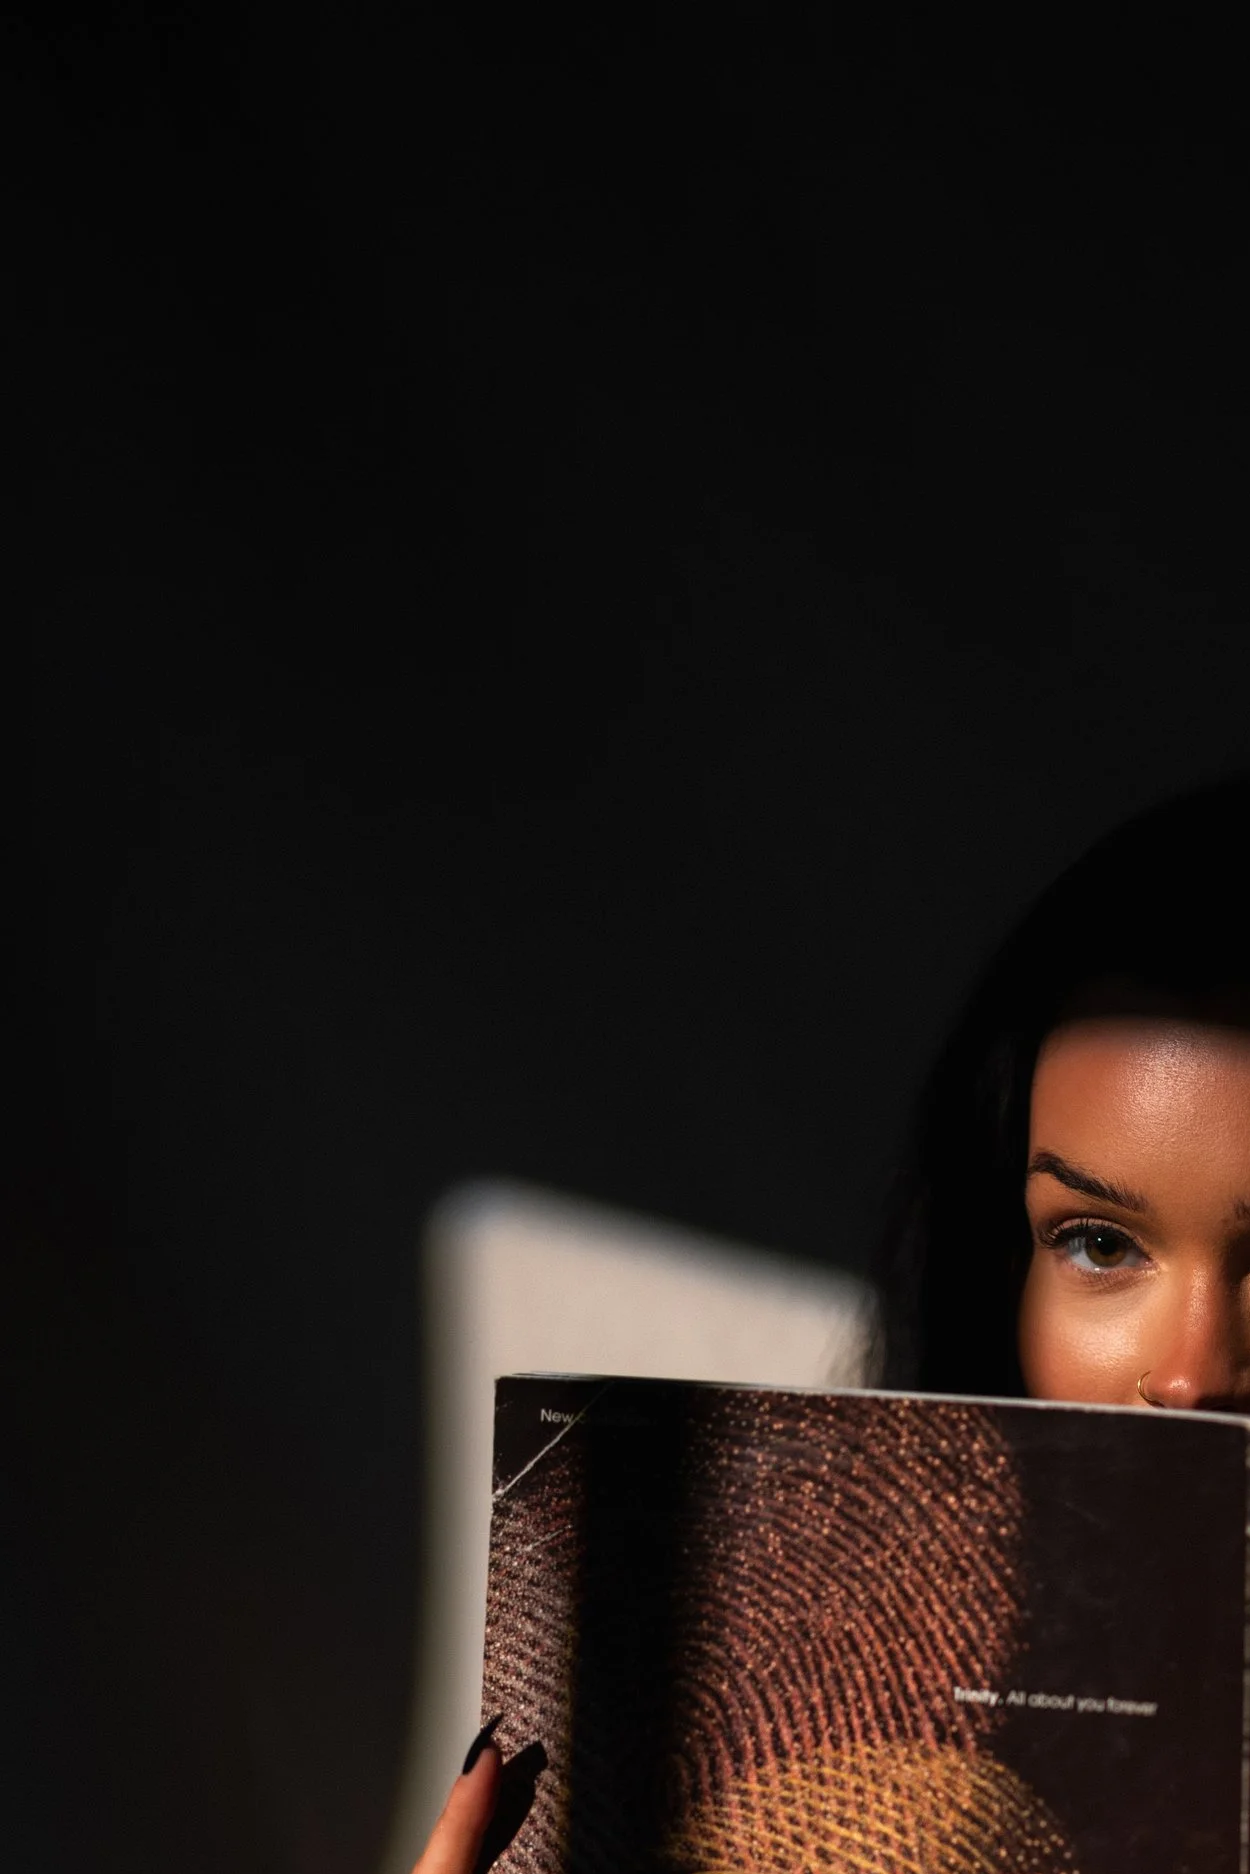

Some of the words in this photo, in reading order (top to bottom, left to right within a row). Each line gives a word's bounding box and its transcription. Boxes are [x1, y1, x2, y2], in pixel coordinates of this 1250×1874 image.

[540, 1407, 575, 1424] New
[1006, 1690, 1025, 1706] All
[1027, 1692, 1075, 1710] about
[1076, 1698, 1105, 1713] you
[1107, 1697, 1158, 1717] forever
